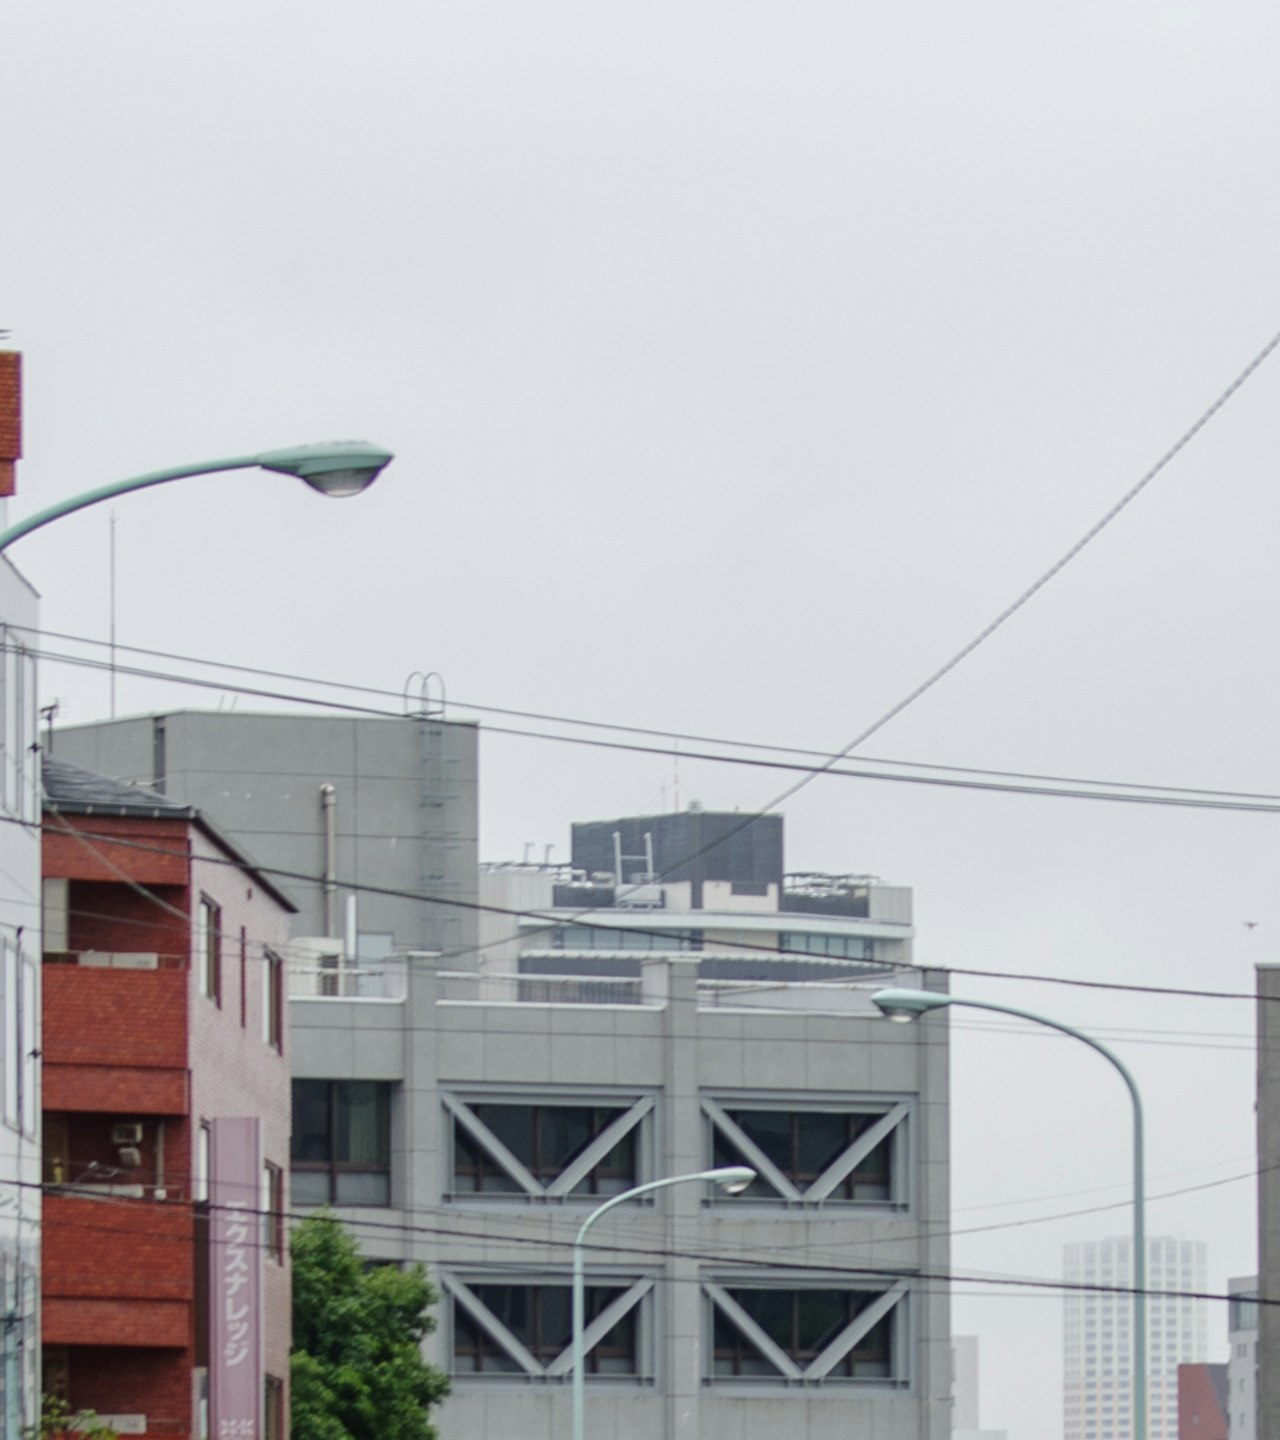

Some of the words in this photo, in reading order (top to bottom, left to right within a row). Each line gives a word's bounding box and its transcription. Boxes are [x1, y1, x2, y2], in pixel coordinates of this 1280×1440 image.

[224, 1200, 250, 1367] エクスナレッジ
